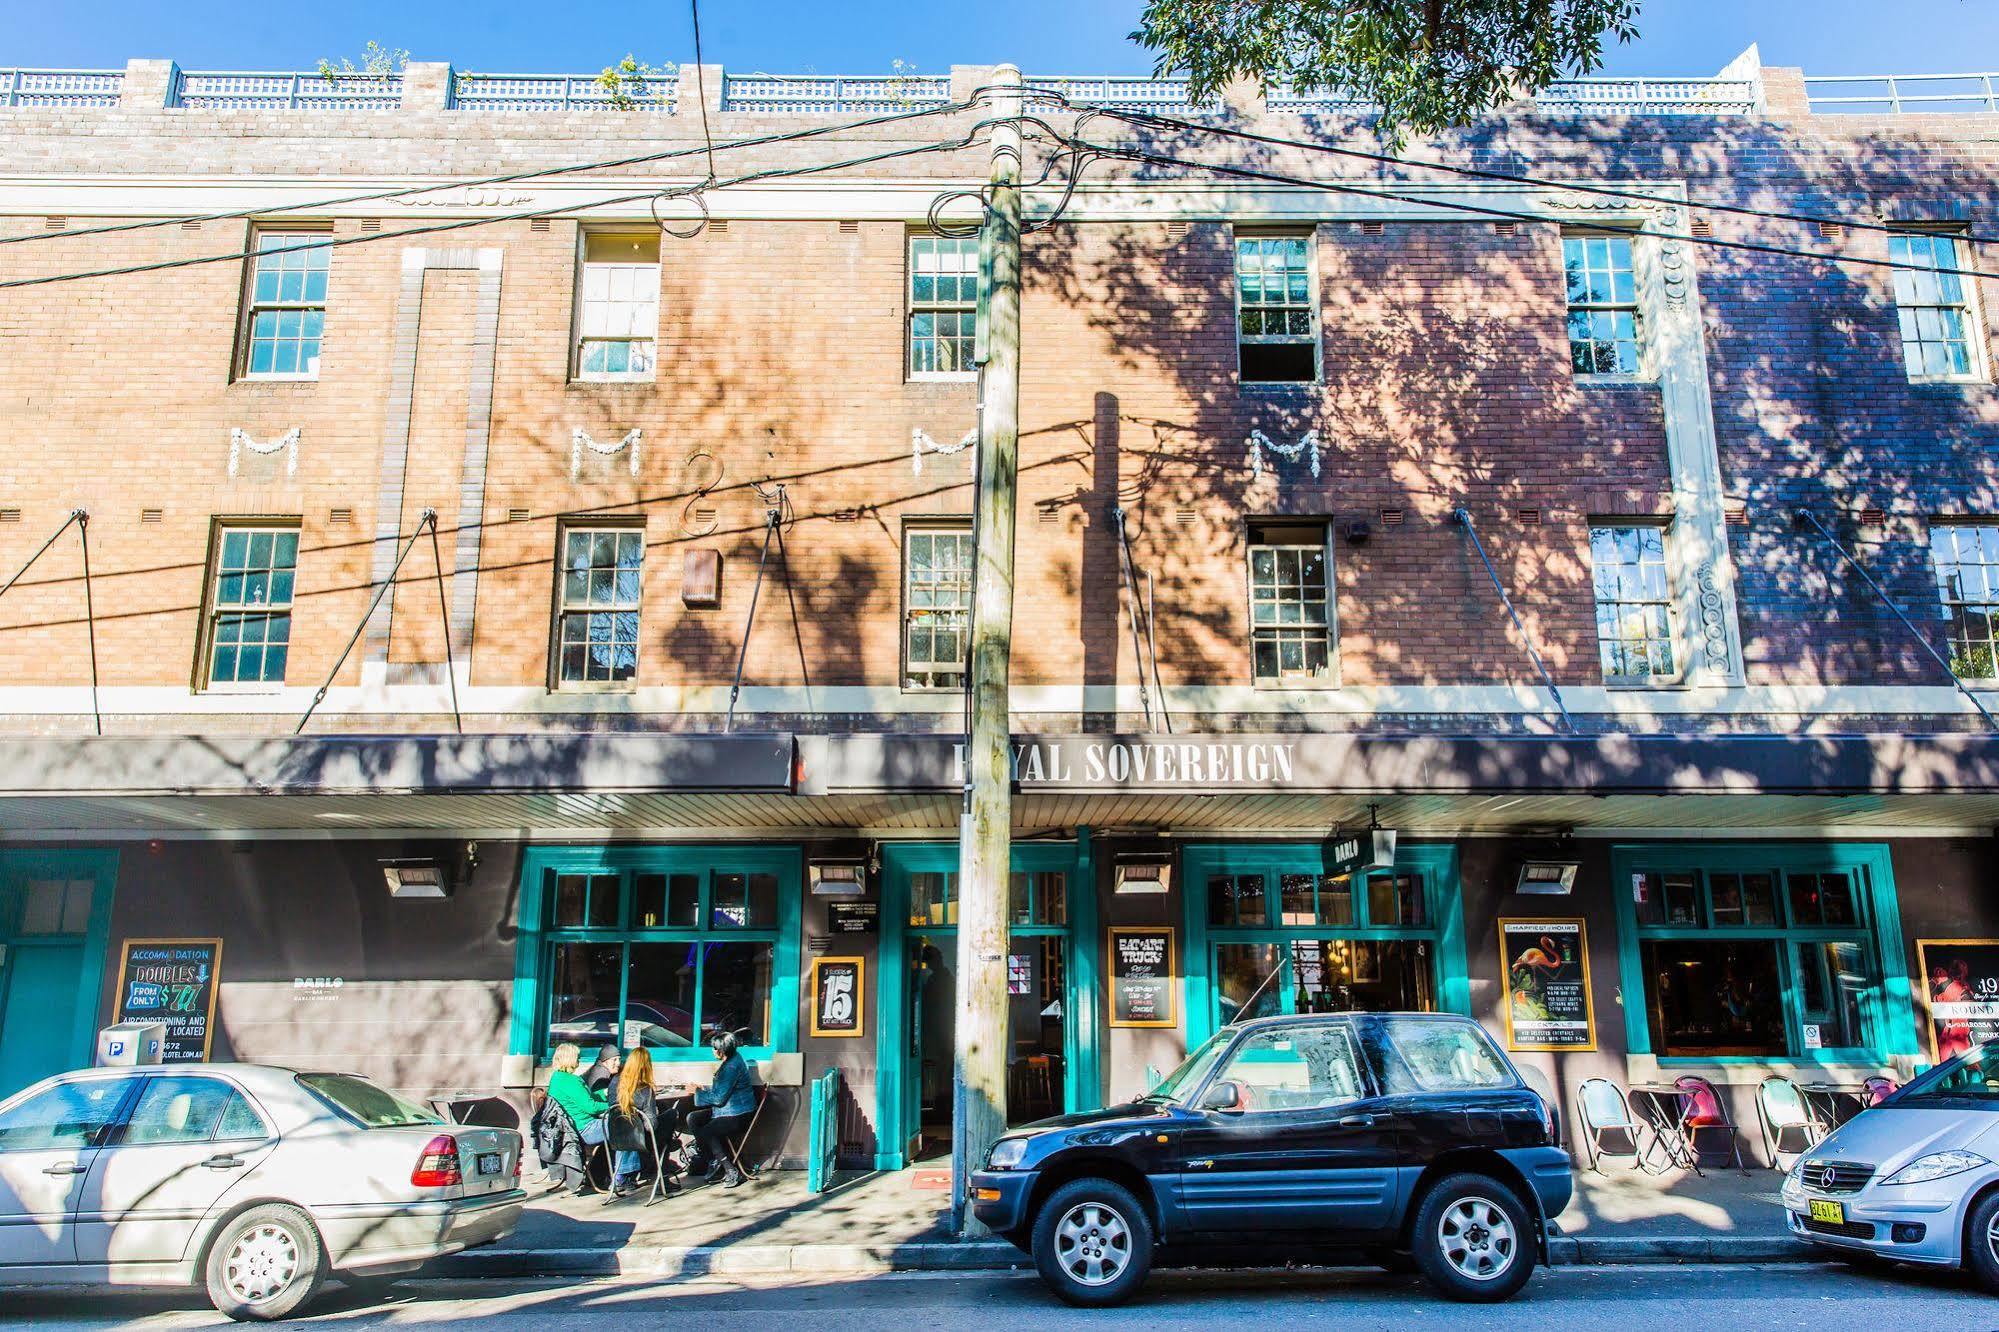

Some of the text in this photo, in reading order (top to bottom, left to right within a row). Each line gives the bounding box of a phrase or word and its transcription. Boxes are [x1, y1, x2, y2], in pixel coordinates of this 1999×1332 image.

[1086, 743, 1294, 782] SOVEREIGN
[1335, 839, 1359, 863] DARLO
[1119, 939, 1165, 951] EAT ART
[131, 950, 209, 960] ACCOMMODATION
[1122, 951, 1163, 963] TRUCK
[137, 966, 196, 983] DOUBLES
[294, 977, 344, 988] DARLO
[133, 986, 157, 996] FROM
[822, 974, 853, 1020] 15
[132, 997, 156, 1006] ONLY
[189, 1016, 206, 1026] AND
[173, 1026, 205, 1036] LOCATED
[110, 1042, 122, 1056] P
[150, 1040, 158, 1054] P
[1186, 1159, 1215, 1169] RAV4
